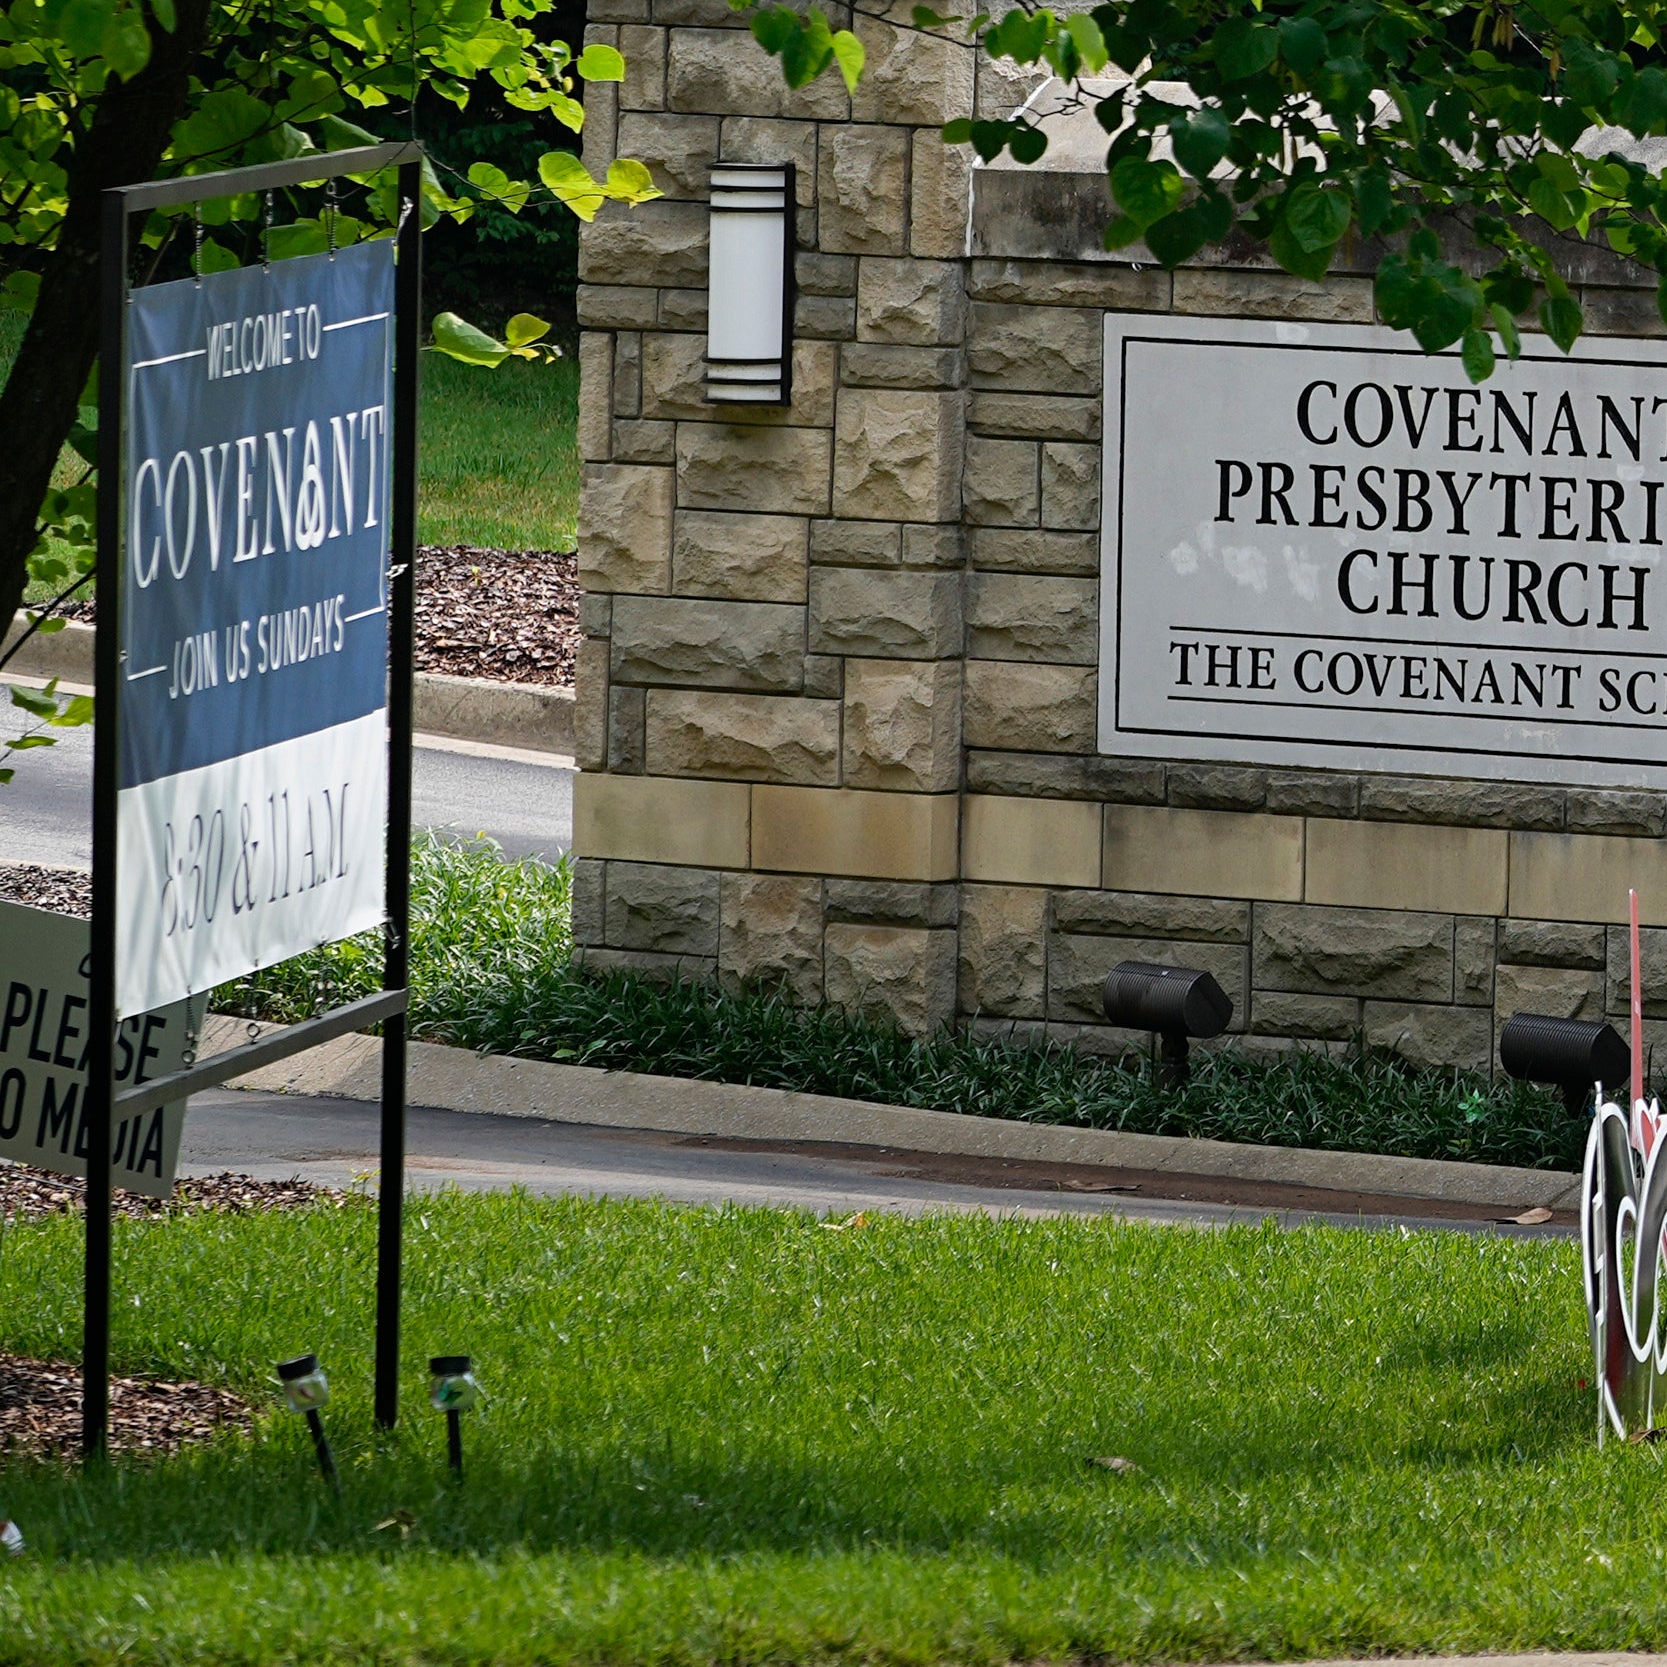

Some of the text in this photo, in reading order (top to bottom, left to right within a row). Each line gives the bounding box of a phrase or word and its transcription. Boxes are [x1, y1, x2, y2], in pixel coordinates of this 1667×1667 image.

[207, 303, 320, 380] WELCOME TO
[134, 405, 384, 589] COVENANT
[1338, 549, 1651, 631] CHURCH
[169, 594, 345, 699] JOIN US SUNDAYS
[1169, 642, 1276, 690] THE
[1293, 649, 1582, 710] COVENANT
[162, 810, 224, 936] 8:30
[233, 803, 259, 915] &
[268, 789, 290, 902] 11
[0, 981, 167, 1085] PLESE
[36, 1077, 163, 1178] MEIA
